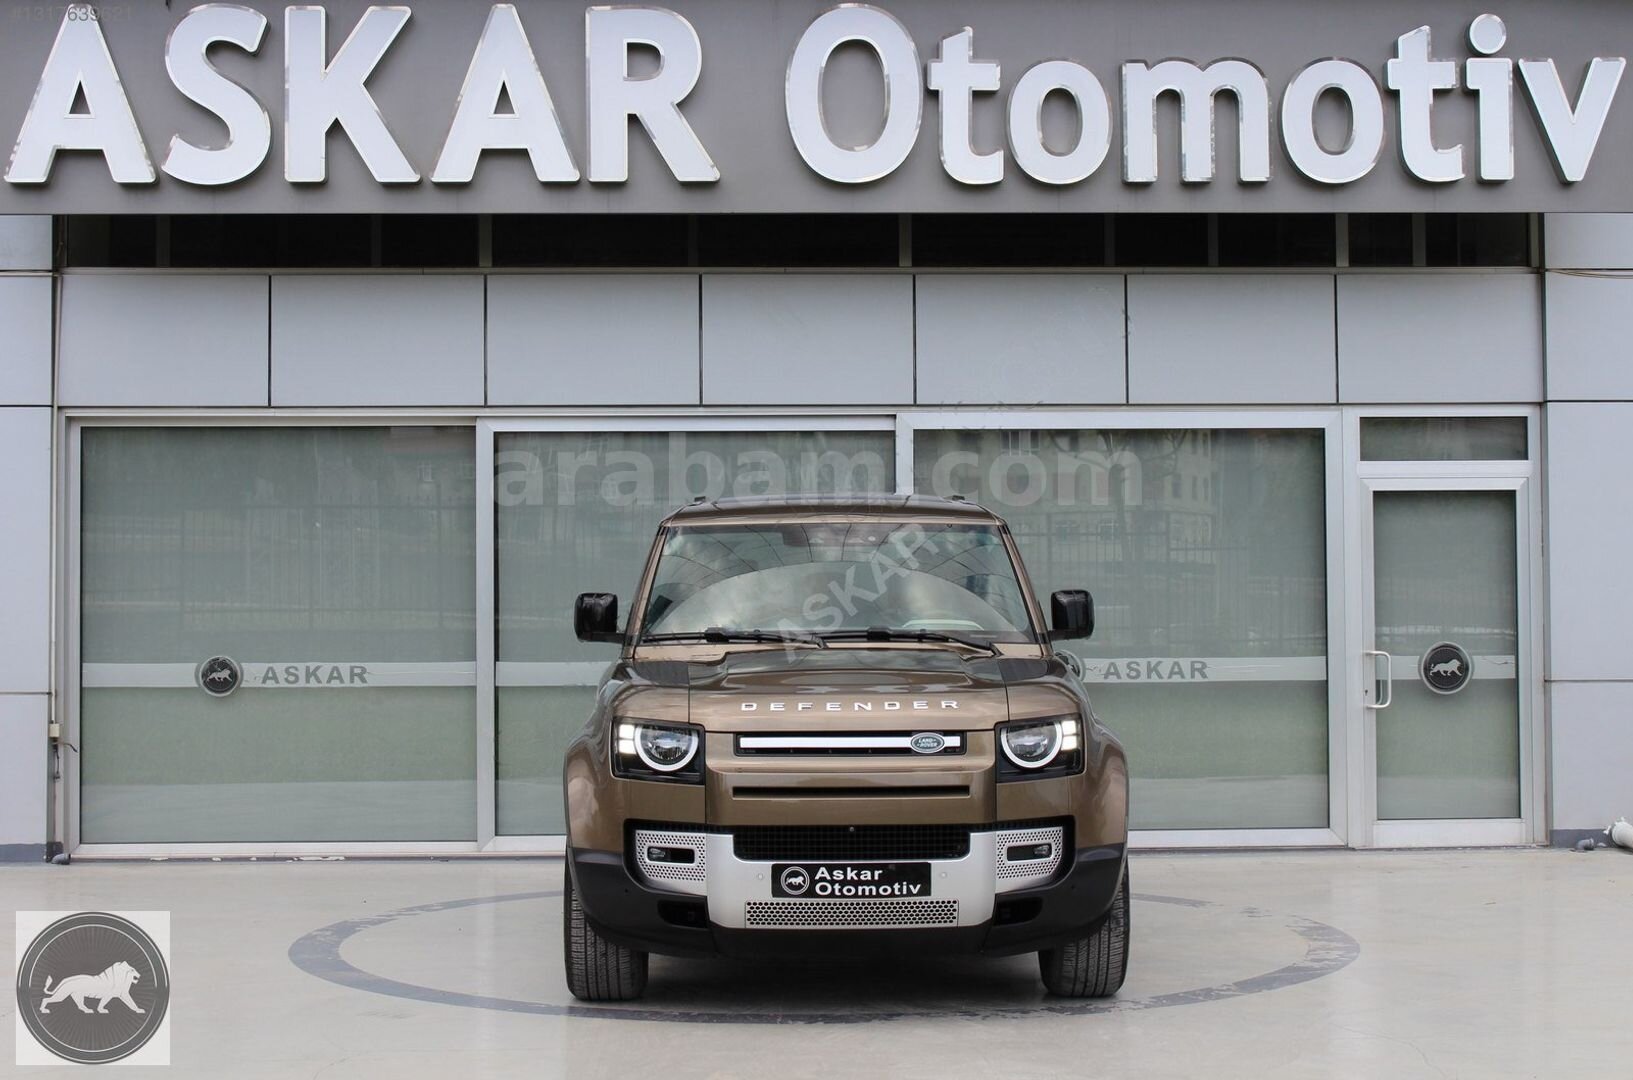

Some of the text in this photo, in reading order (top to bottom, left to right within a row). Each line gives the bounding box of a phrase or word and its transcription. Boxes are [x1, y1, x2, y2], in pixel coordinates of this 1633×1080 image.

[4, 2, 1627, 187] ASKAR Otomotiv
[260, 664, 369, 685] ASKAR
[1103, 660, 1209, 681] ASKAR
[740, 700, 960, 712] DEFENDER
[814, 866, 884, 881] Askar
[814, 881, 922, 897] Otomotiv
